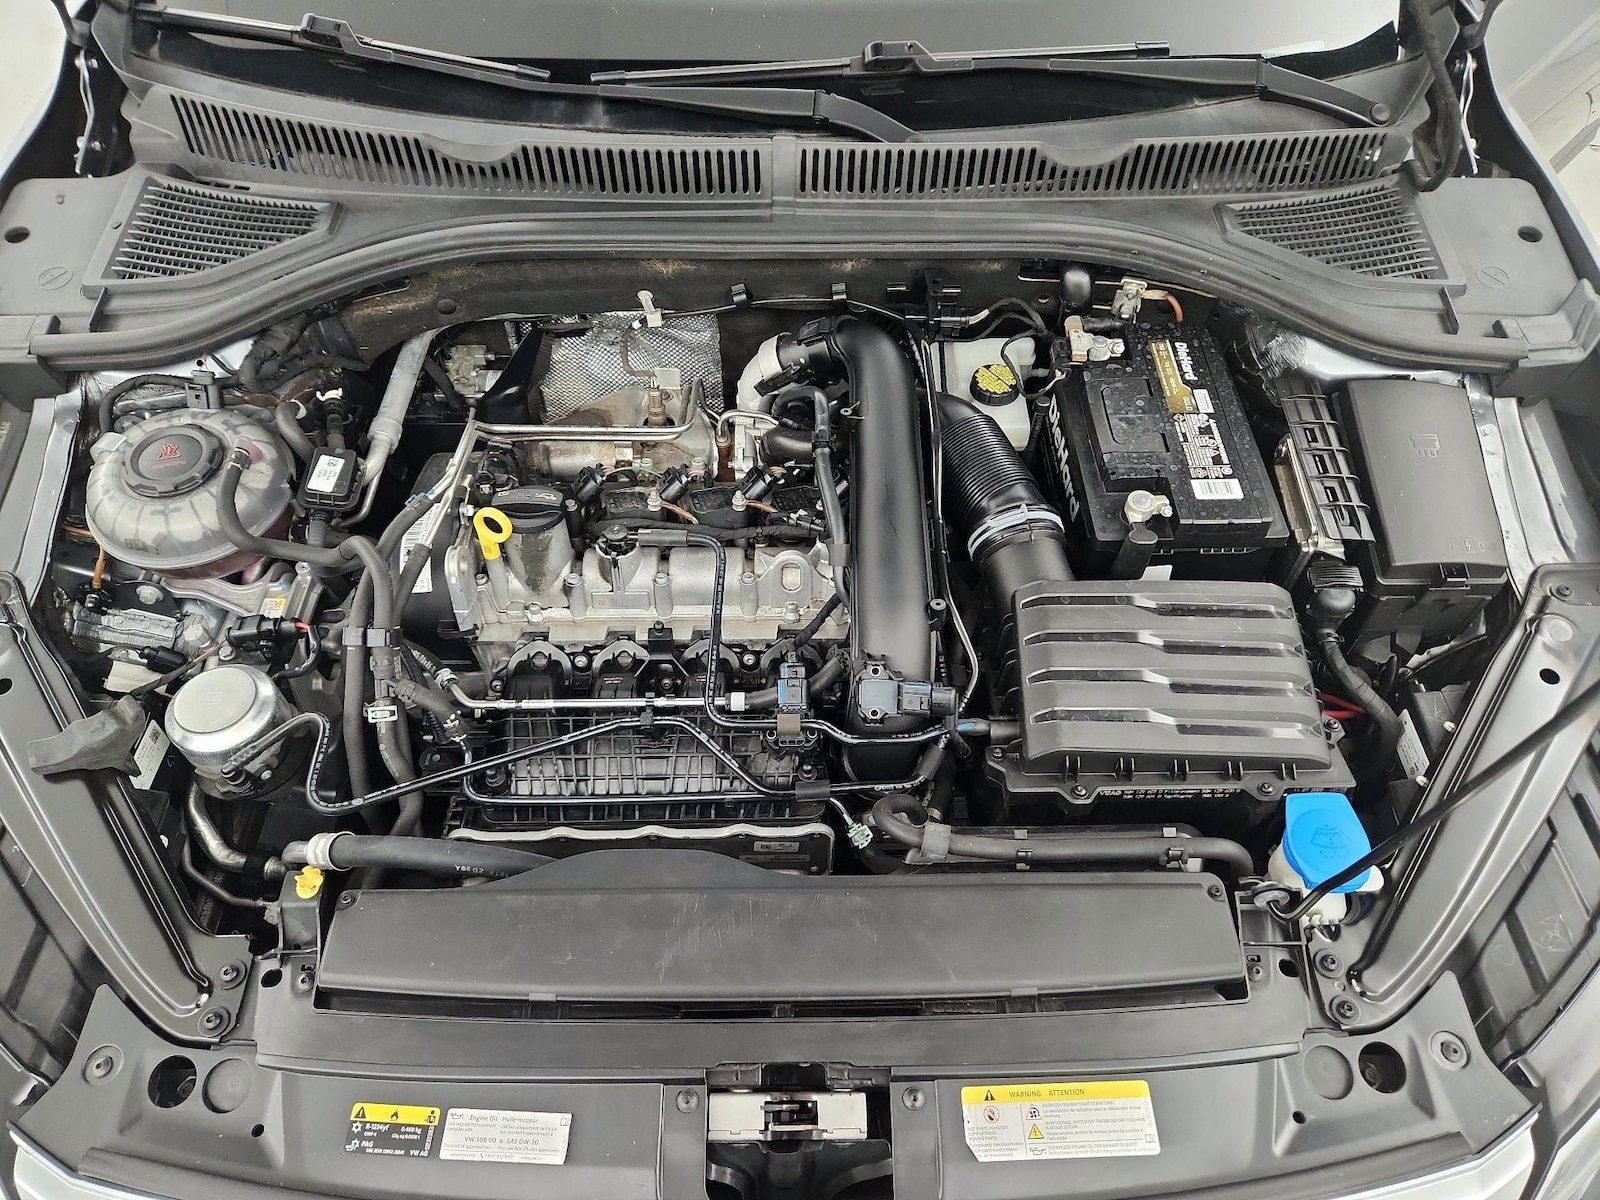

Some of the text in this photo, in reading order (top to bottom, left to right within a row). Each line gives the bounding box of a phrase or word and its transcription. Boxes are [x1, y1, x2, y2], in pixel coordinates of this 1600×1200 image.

[1174, 342, 1198, 380] DieHard
[1182, 396, 1194, 410] GOLD
[1049, 393, 1080, 522] DieHard
[366, 1123, 389, 1132] R-1234yf
